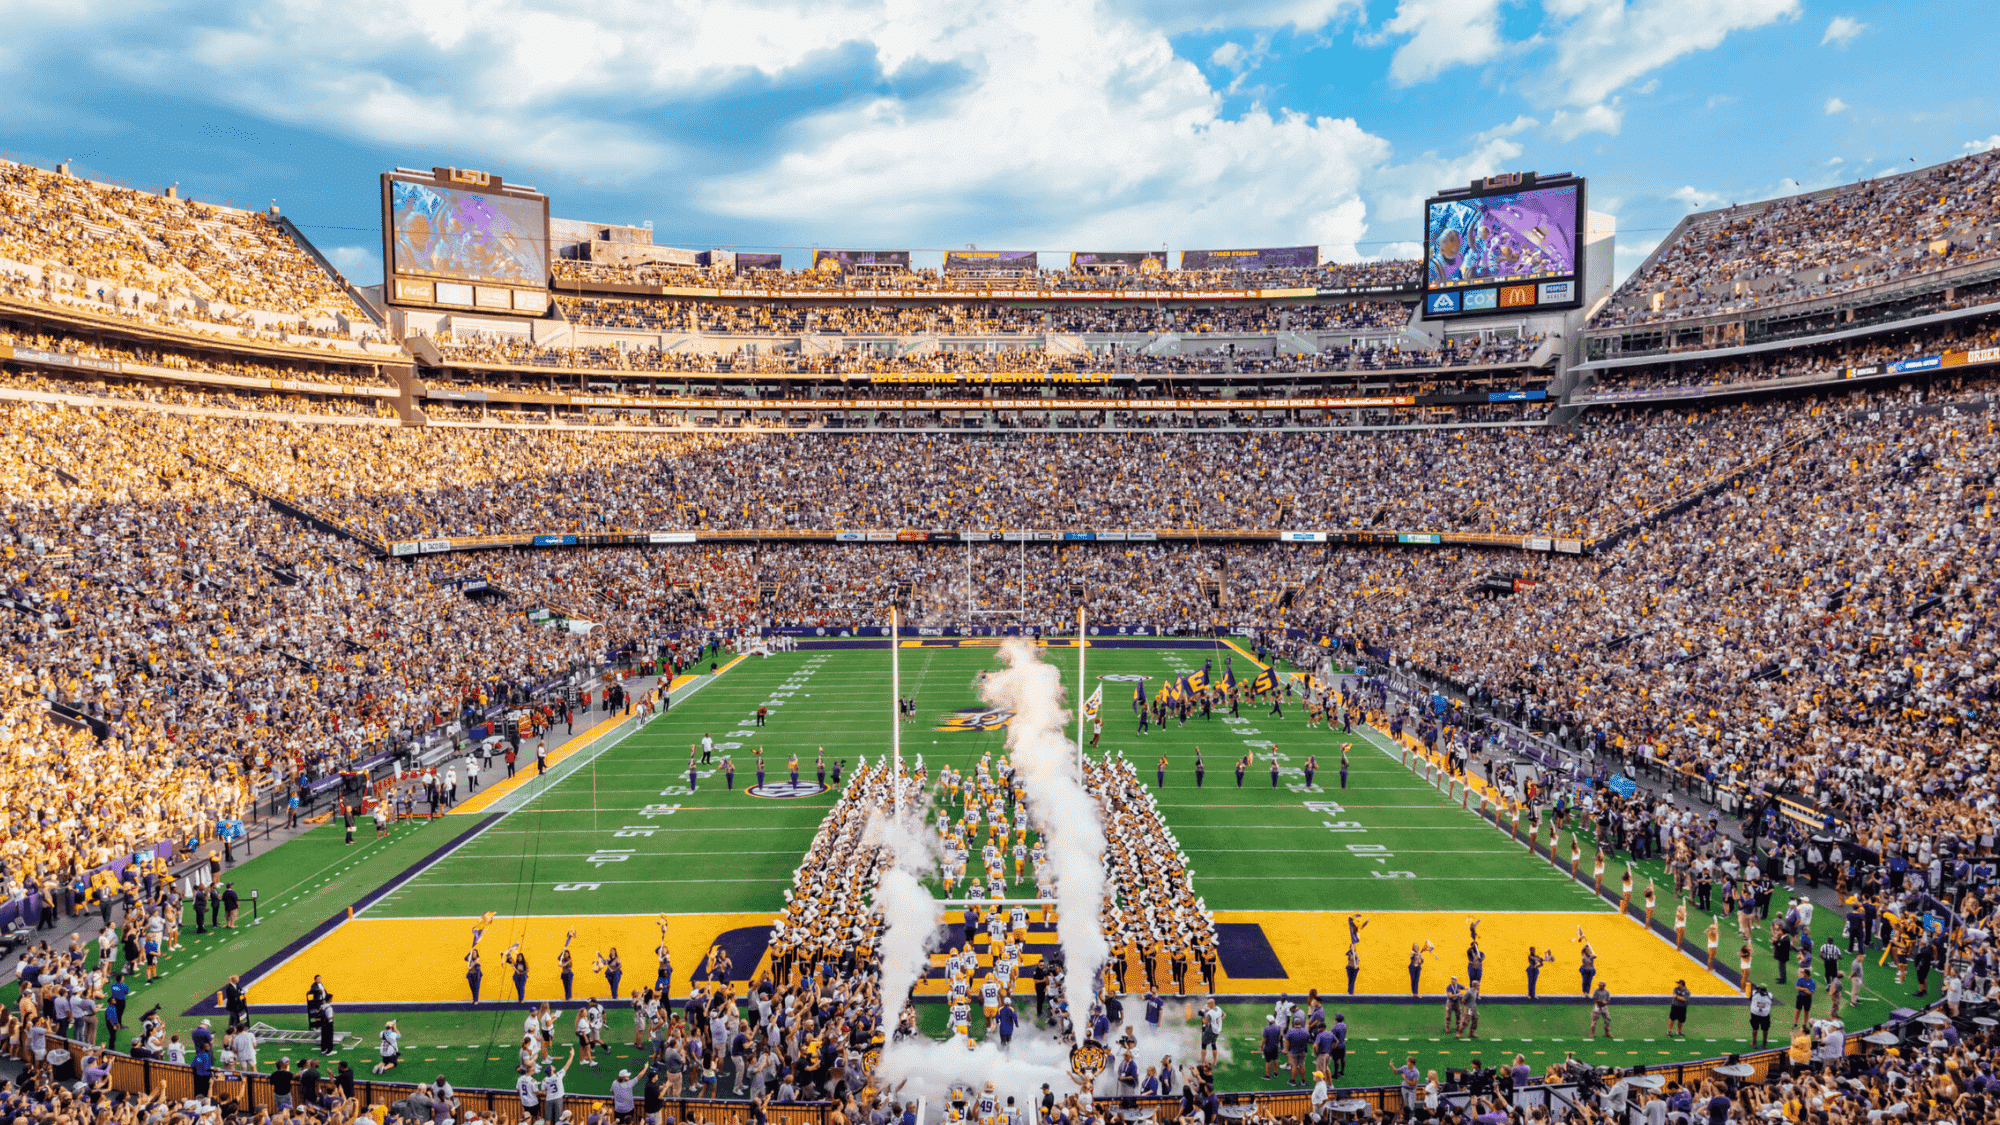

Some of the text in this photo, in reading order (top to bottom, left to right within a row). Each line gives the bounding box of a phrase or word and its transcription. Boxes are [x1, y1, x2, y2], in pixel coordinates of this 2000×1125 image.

[450, 167, 490, 186] LSU
[1483, 171, 1523, 190] LSU
[1465, 292, 1495, 305] COX
[1968, 347, 2000, 363] ORDER
[871, 372, 1112, 383] WELCOME TO DEATH VALLEY
[1188, 670, 1206, 693] E
[1255, 672, 1272, 693] S
[613, 825, 660, 837] 15
[1322, 821, 1368, 832] 15
[585, 849, 636, 862] 10
[1345, 844, 1395, 857] 10
[553, 883, 601, 891] 5
[1014, 913, 1023, 921] 77
[992, 926, 999, 934] 71
[951, 961, 959, 970] 14
[966, 956, 974, 964] 47
[999, 964, 1009, 974] 33
[954, 985, 965, 995] 40
[985, 988, 996, 997] 68
[955, 1011, 966, 1020] 82
[171, 1052, 177, 1061] 9
[522, 1084, 528, 1096] 9
[550, 1083, 558, 1093] 3
[980, 1100, 993, 1112] 49
